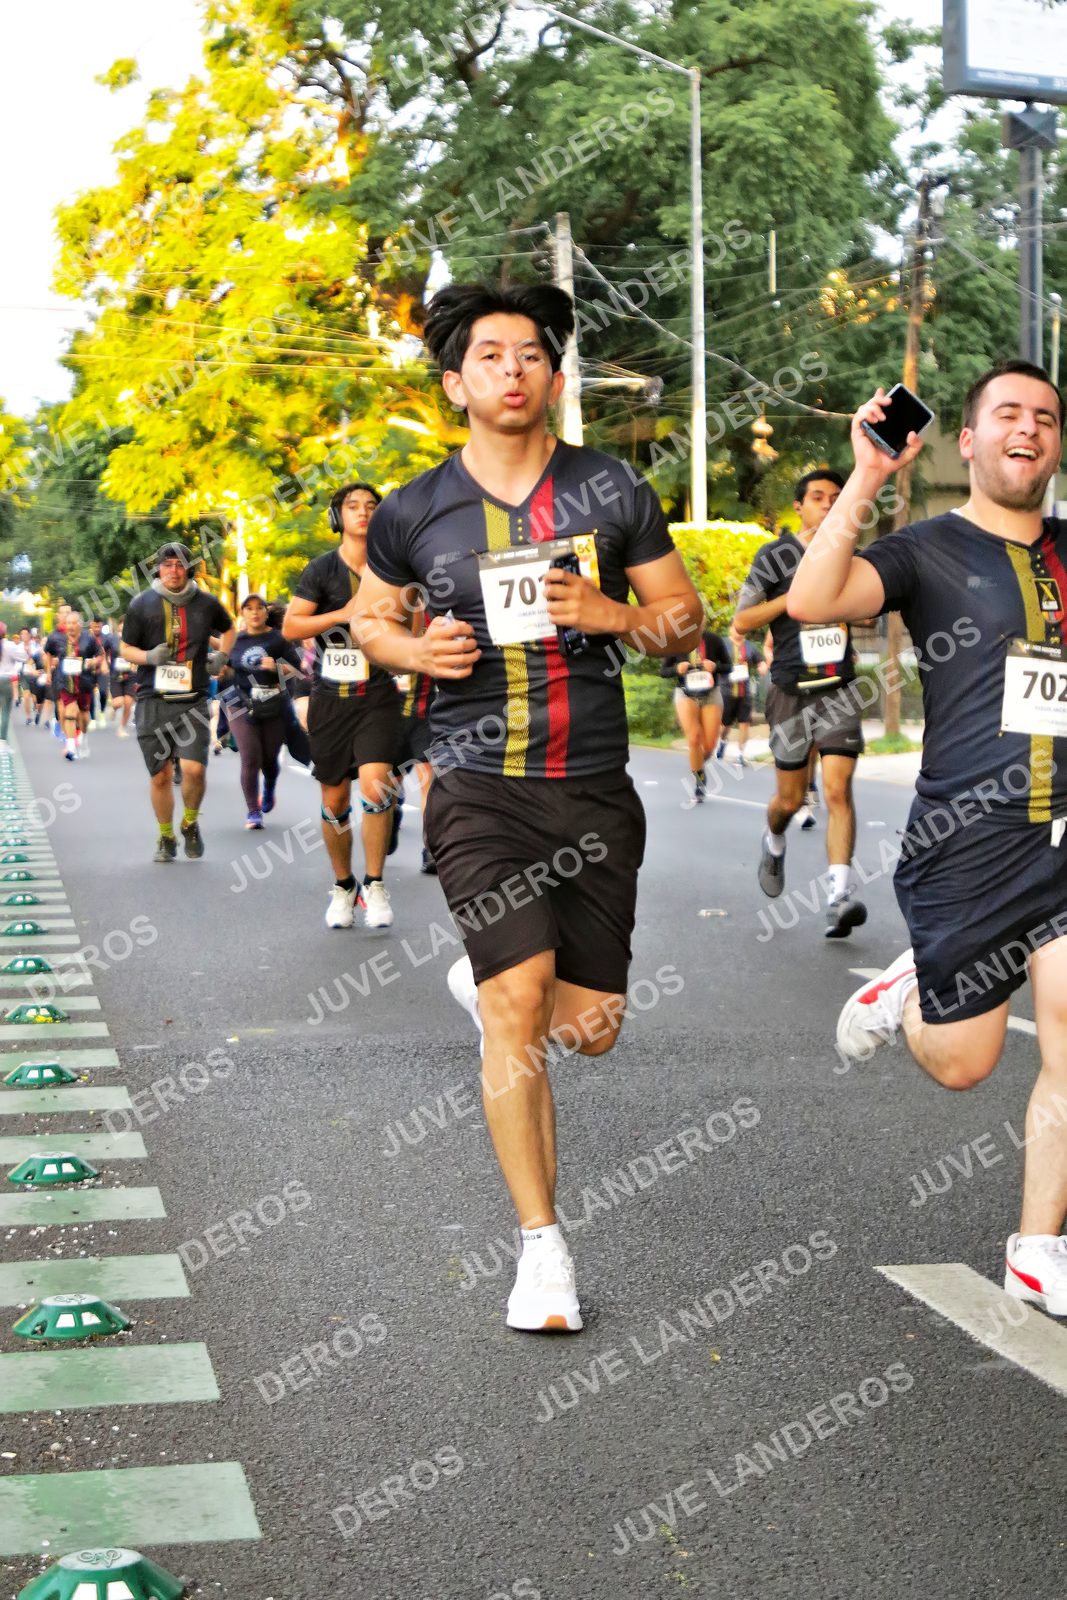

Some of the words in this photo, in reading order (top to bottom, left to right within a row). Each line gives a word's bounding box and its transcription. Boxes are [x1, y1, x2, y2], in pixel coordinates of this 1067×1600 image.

[499, 575, 546, 609] 70
[808, 633, 841, 649] 7060
[327, 654, 357, 666] 1903
[162, 668, 186, 679] 7009
